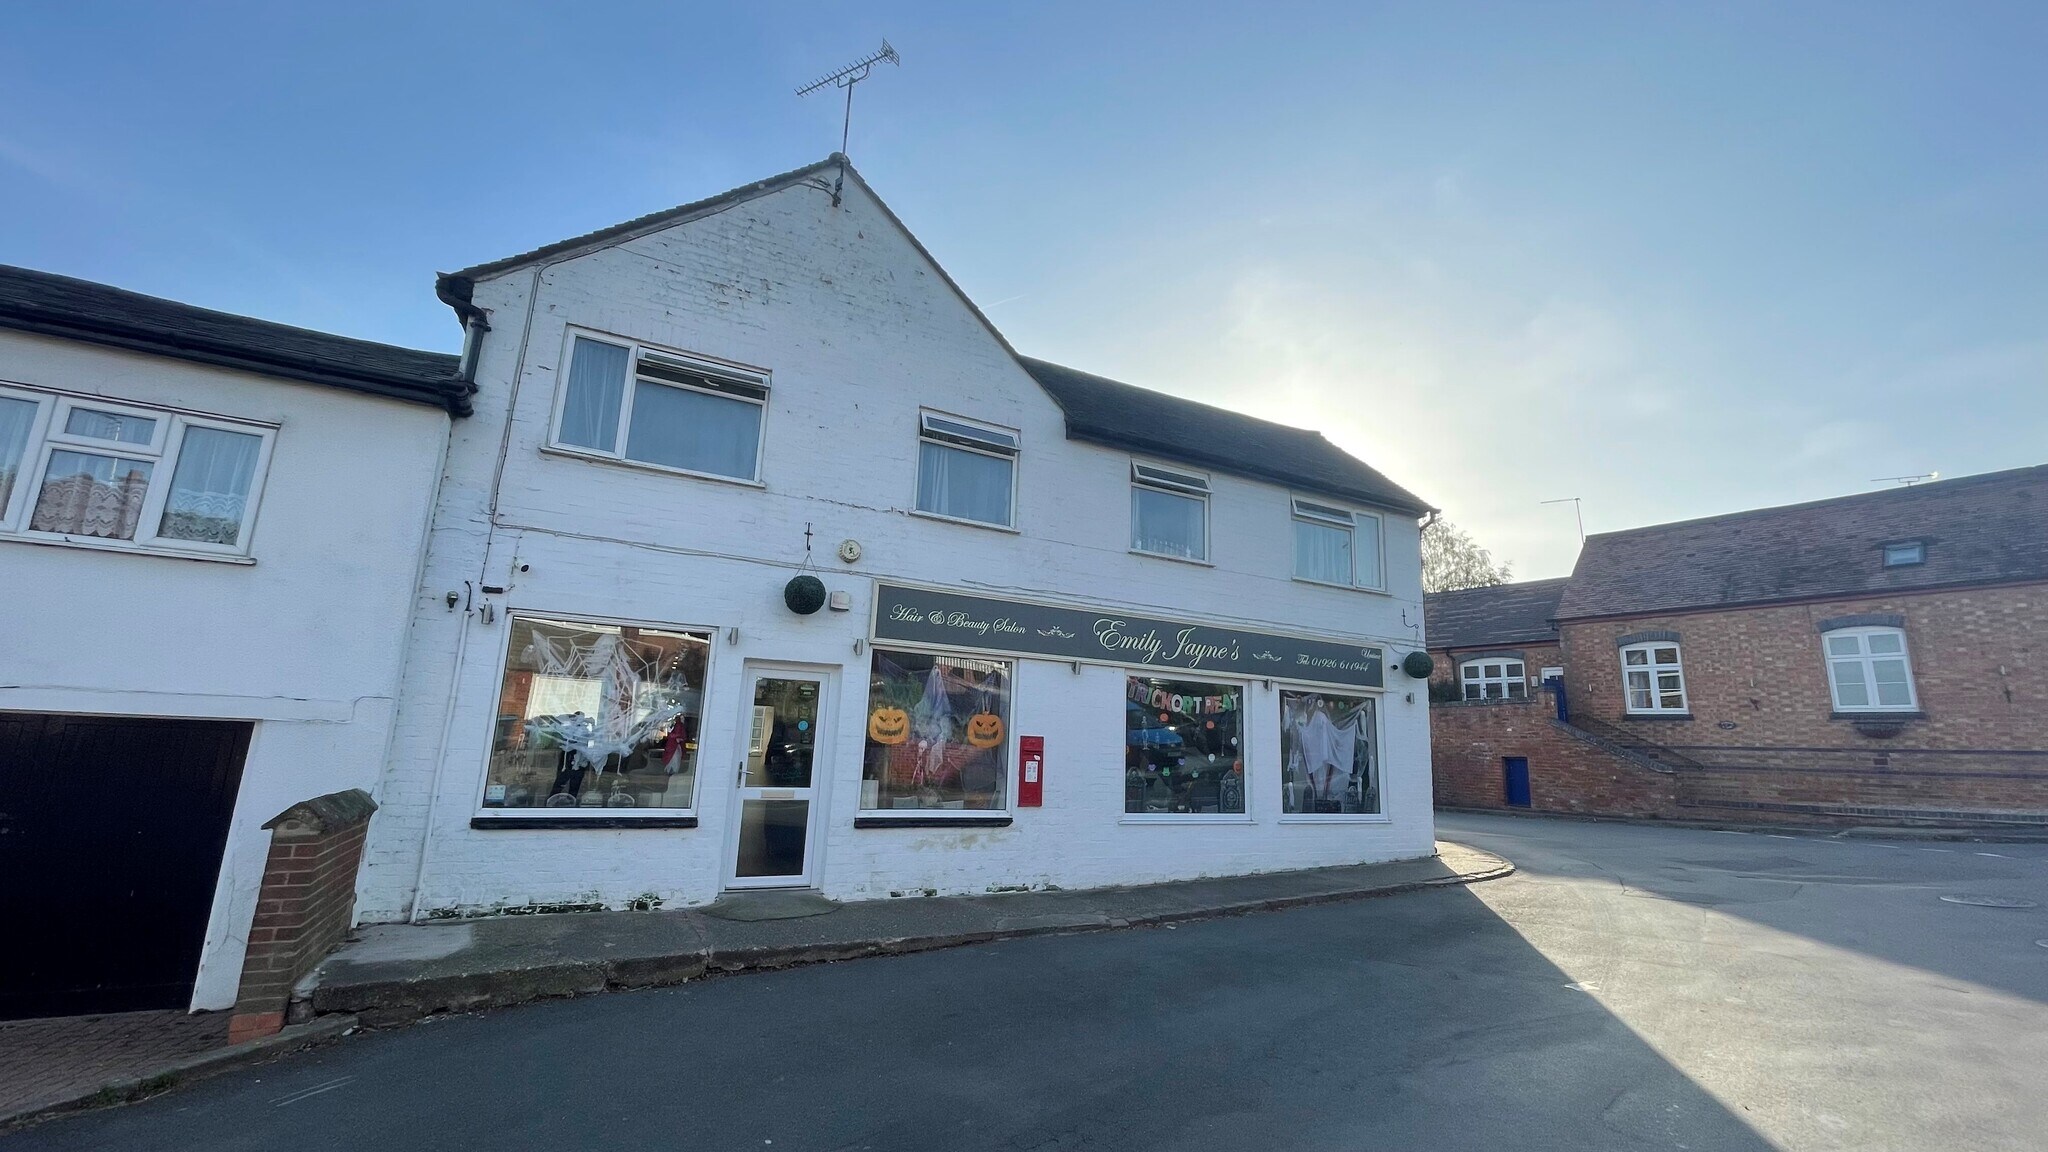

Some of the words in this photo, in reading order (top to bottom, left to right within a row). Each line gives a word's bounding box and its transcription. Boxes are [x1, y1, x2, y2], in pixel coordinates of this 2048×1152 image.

[889, 604, 924, 623] Hair
[928, 610, 945, 625] &
[947, 611, 990, 635] Beauty
[993, 617, 1027, 634] Salon
[1093, 618, 1163, 664] Emily
[1162, 626, 1239, 669] Jayne's
[1311, 657, 1338, 670] 01926
[1340, 660, 1369, 672] 611944
[1127, 676, 1172, 711] TRICK
